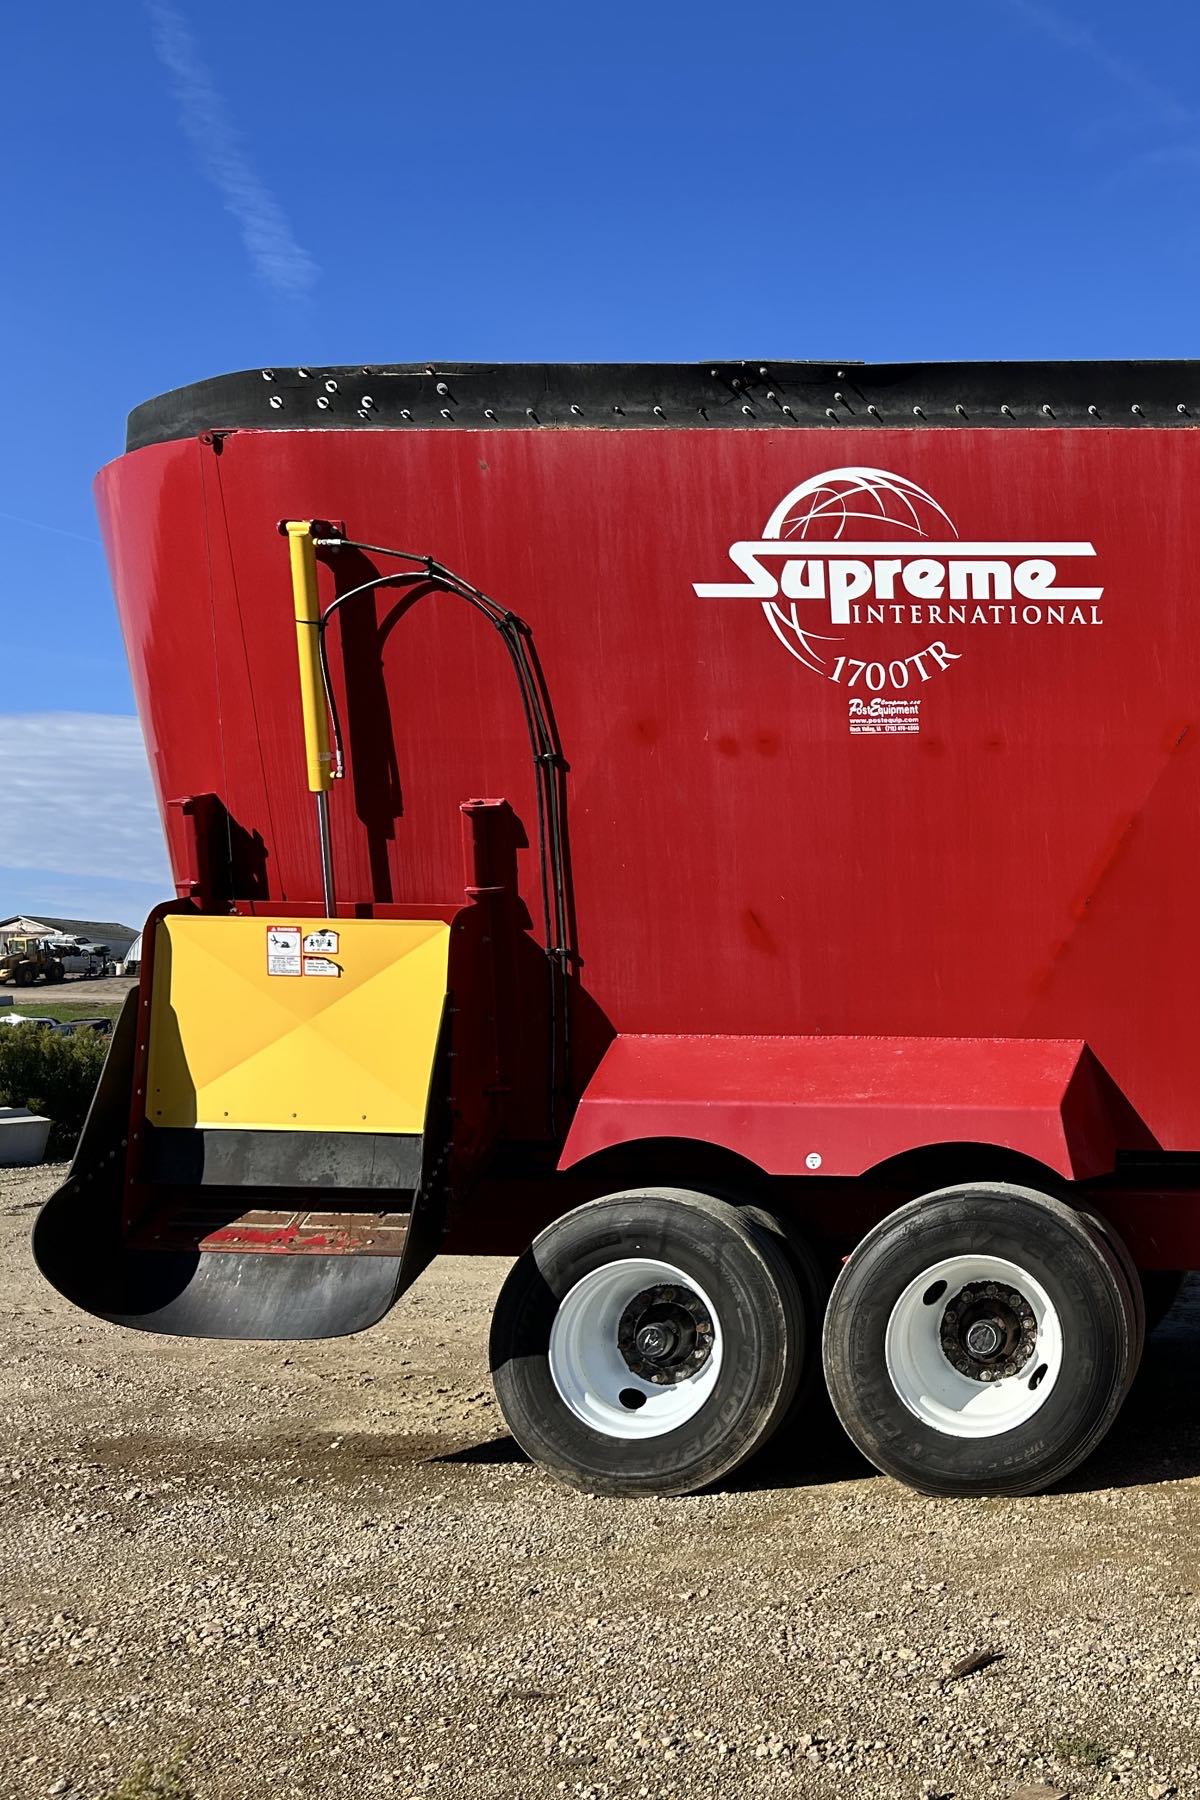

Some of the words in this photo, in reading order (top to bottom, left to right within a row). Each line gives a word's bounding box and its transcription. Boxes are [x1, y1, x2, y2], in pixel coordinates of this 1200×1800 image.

[692, 541, 1104, 624] Supreme
[852, 604, 1104, 625] INTERNATIONAL
[828, 640, 963, 692] 1700TR
